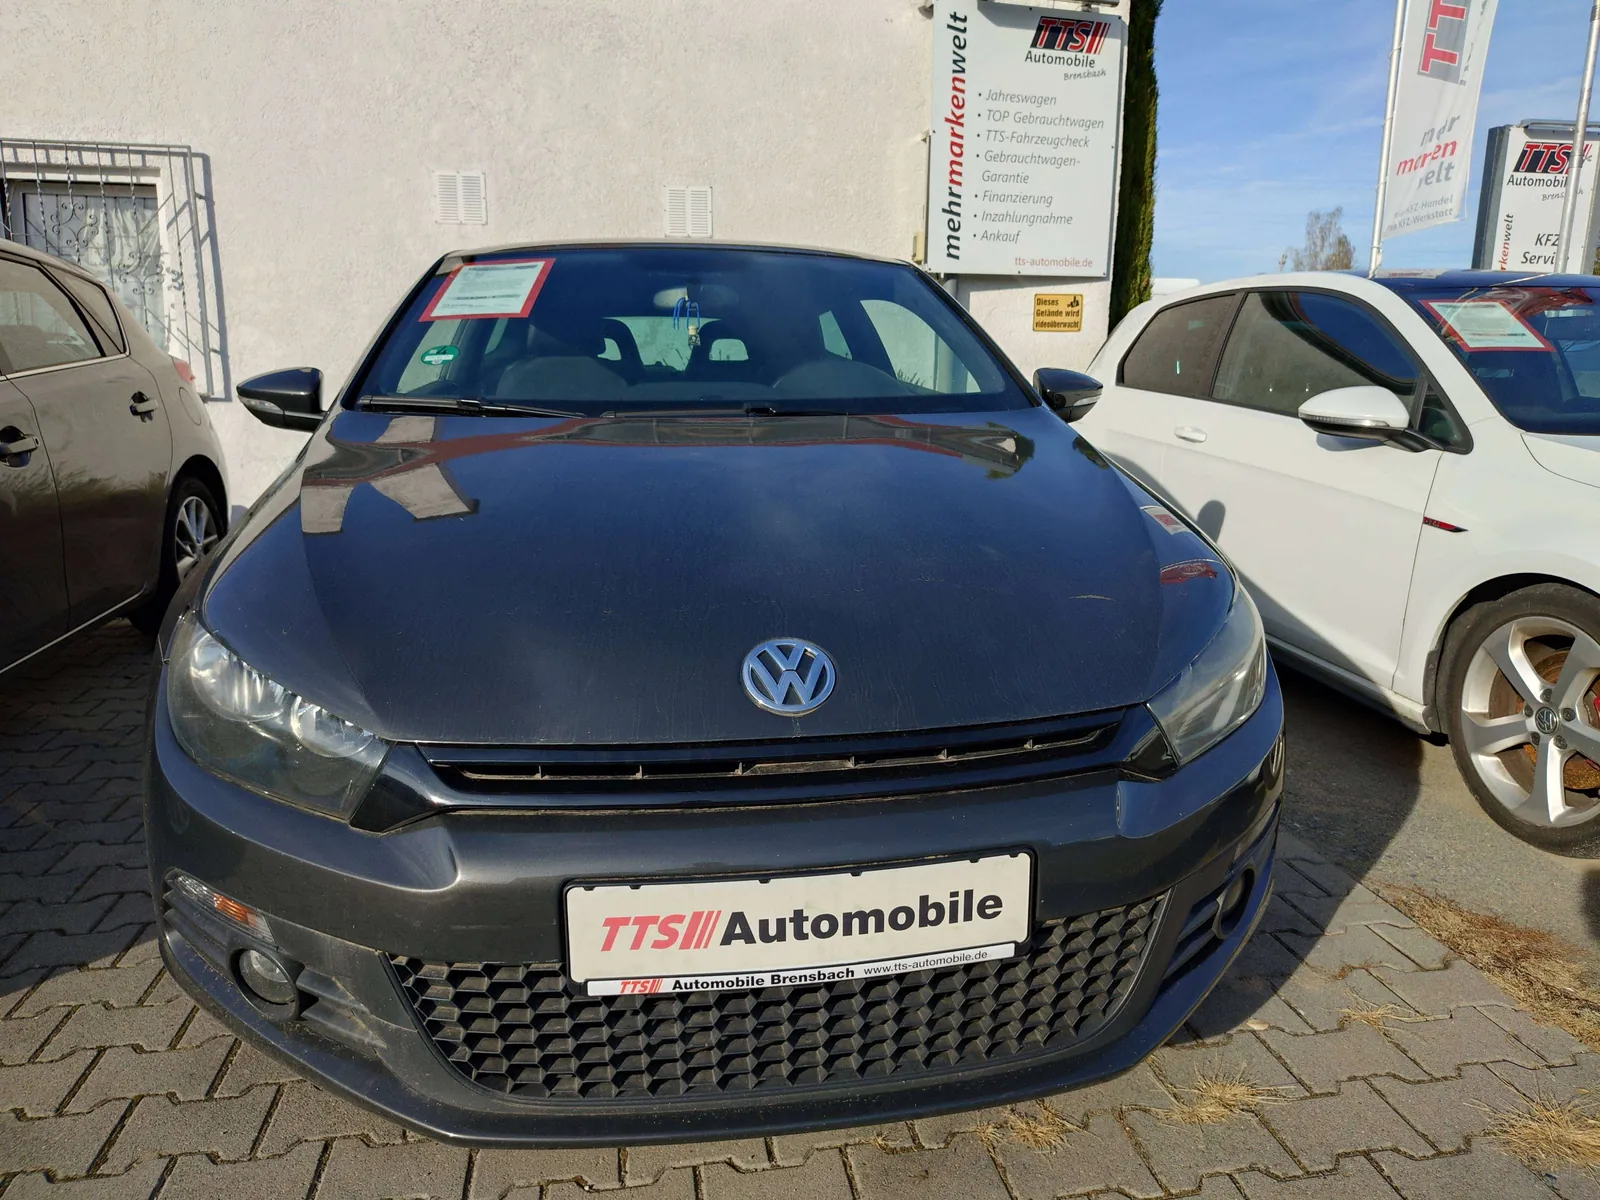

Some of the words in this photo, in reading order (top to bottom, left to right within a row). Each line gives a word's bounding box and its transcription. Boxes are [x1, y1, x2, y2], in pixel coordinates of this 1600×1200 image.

[1037, 17, 1092, 52] TTS
[1025, 50, 1096, 68] Automobile
[1063, 68, 1107, 81] Brensbach
[986, 89, 1057, 108] Jahreswagen
[986, 110, 1010, 122] TOP
[1013, 111, 1104, 131] Gebrauchtwagen
[942, 11, 968, 260] mehrmarkenwelt
[986, 130, 1090, 149] TTS-Fahrzeugcheck
[984, 150, 1081, 169] Gebrauchtwagen-
[981, 170, 1030, 184] Garantie
[1507, 174, 1567, 188] Automobil
[982, 190, 1053, 207] Finanzierung
[981, 211, 1073, 226] Inzahlungnahme
[980, 230, 1021, 244] Ankauf
[1015, 257, 1093, 268] tts-automobile.de
[1036, 298, 1059, 306] Dieses
[1036, 309, 1063, 317] Gelände
[1065, 309, 1080, 317] wird
[601, 913, 682, 952] TTS
[720, 889, 1003, 946] Automobile
[619, 981, 649, 994] TTS
[672, 975, 765, 990] Automobile
[771, 968, 855, 985] Brensbach
[864, 950, 988, 975] www.tts-automobile.de
